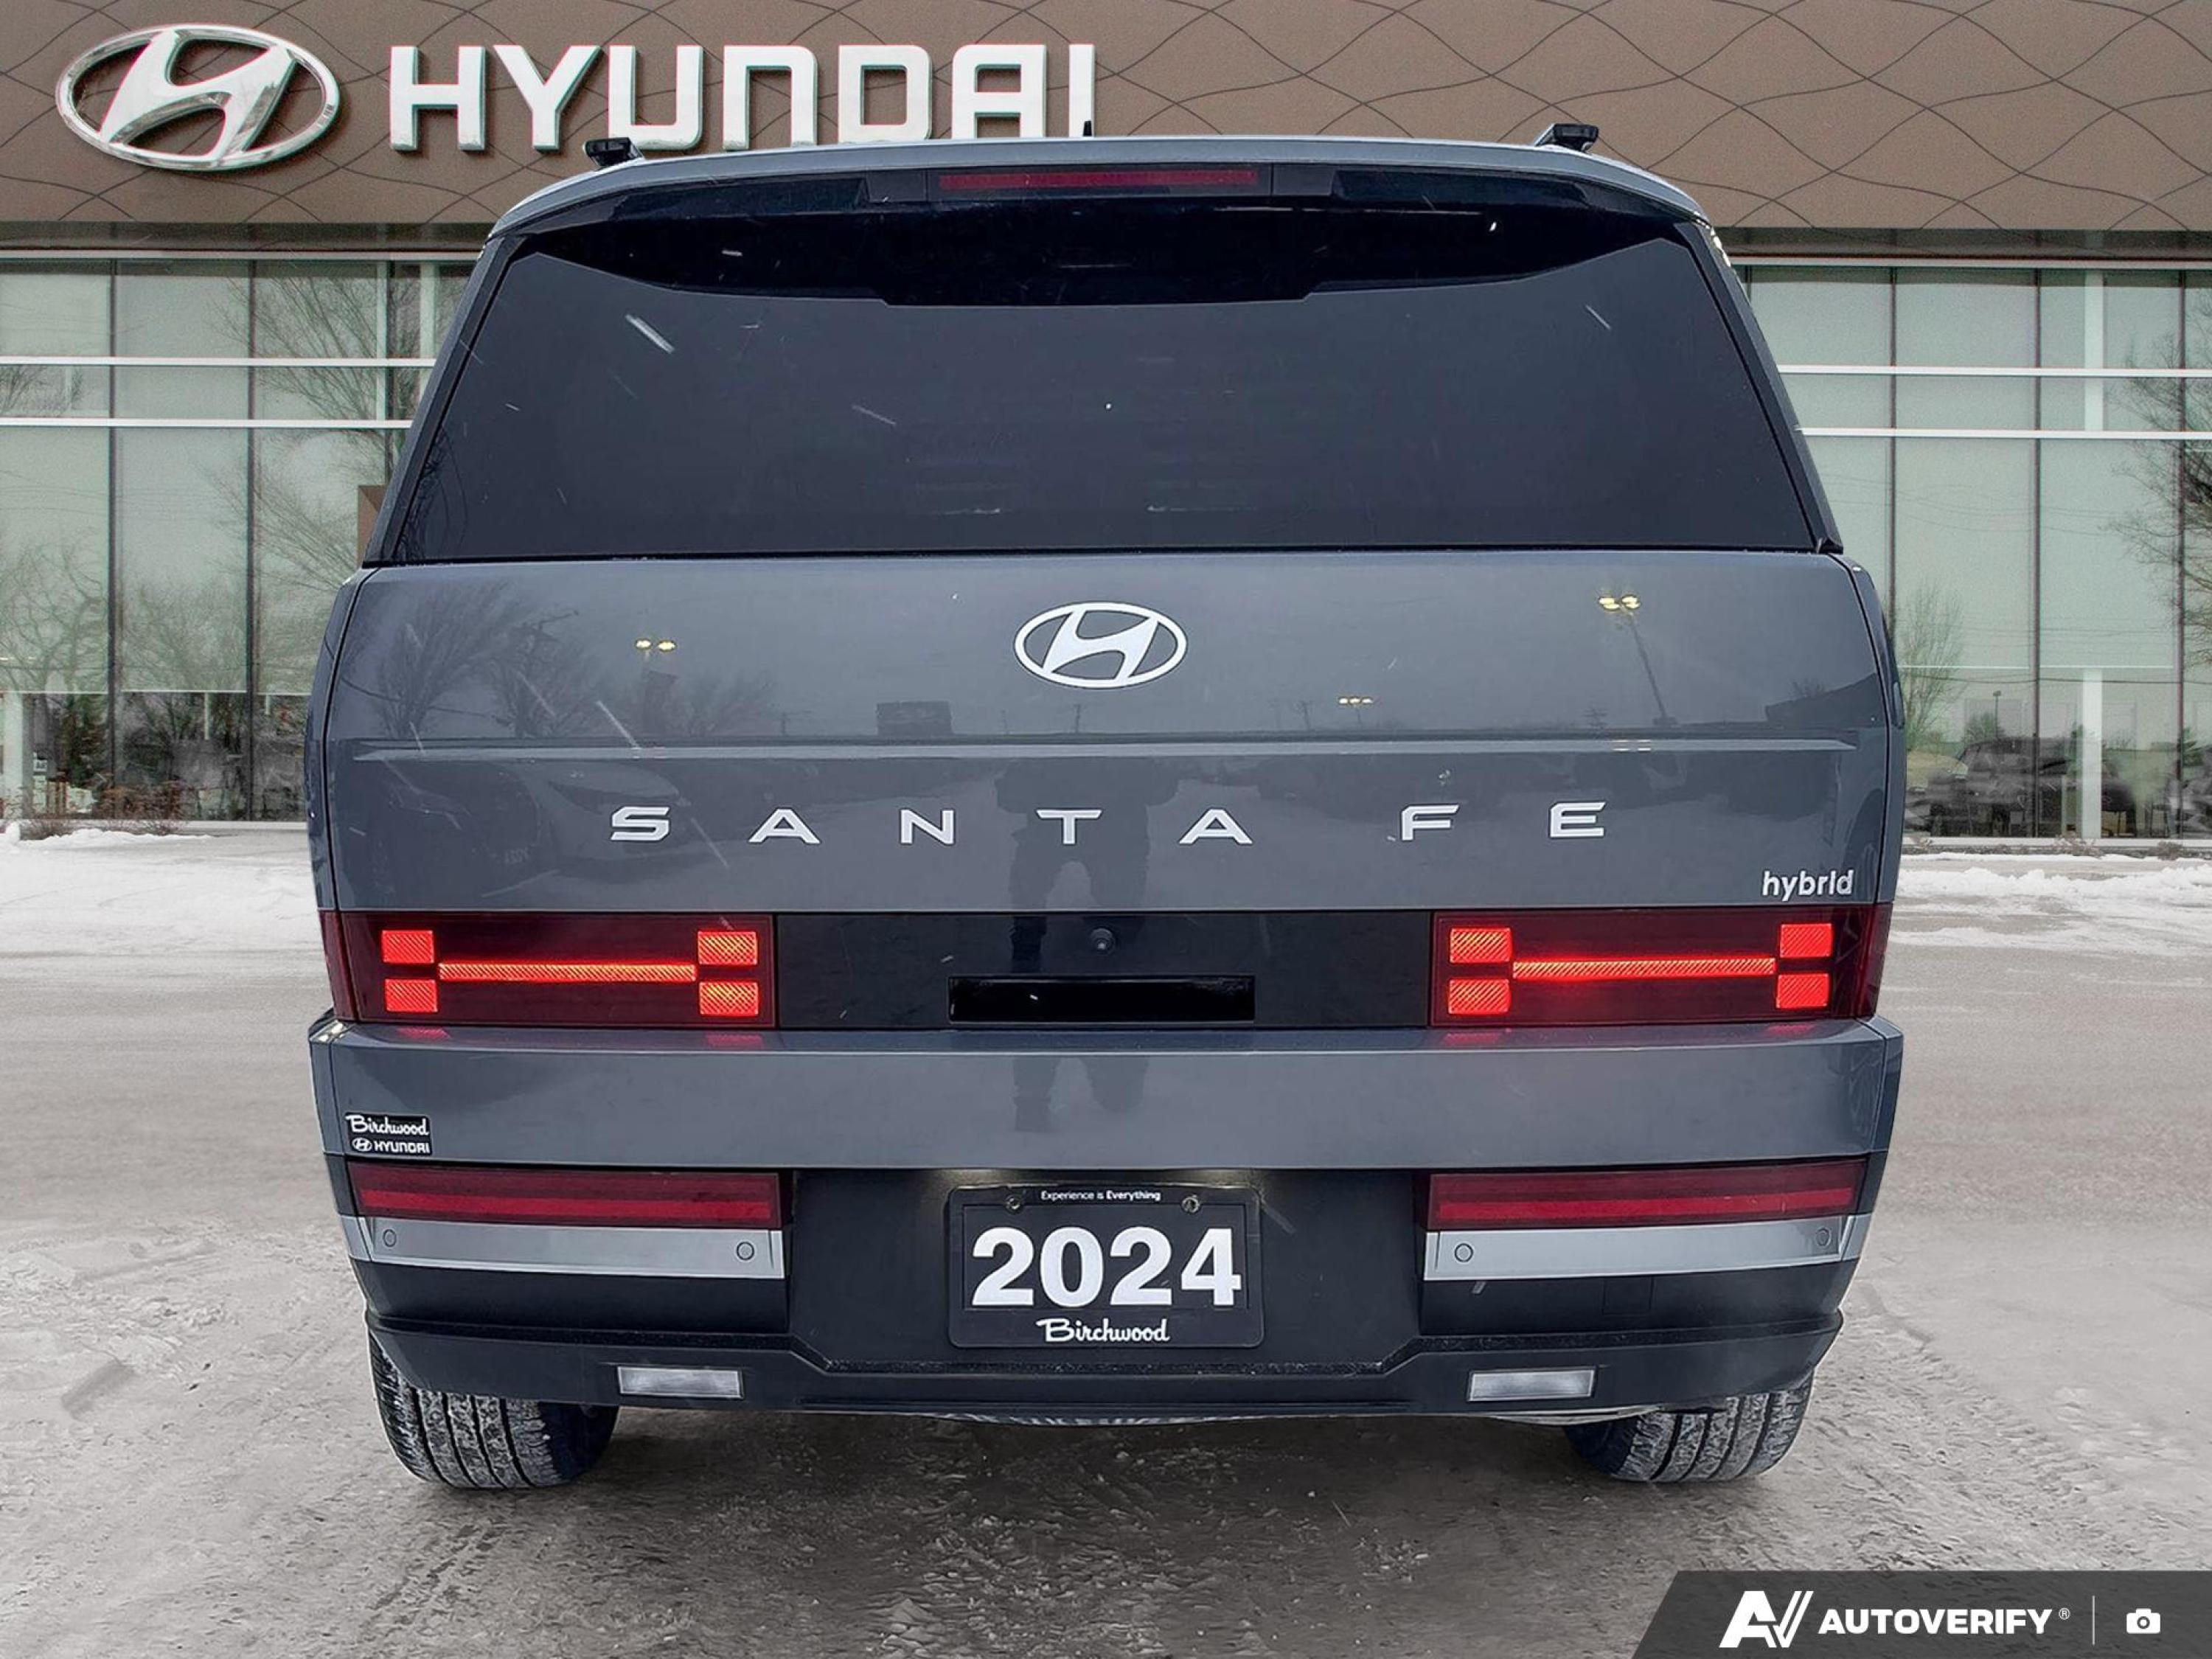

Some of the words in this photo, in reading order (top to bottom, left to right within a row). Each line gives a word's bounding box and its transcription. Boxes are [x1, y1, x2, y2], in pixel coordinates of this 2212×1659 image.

[389, 43, 1096, 152] HYUNDAI
[611, 806, 1253, 846] SANTA
[1401, 801, 1607, 841] FE
[1761, 869, 1854, 902] hybrid
[344, 1114, 430, 1135] Birchwood
[374, 1140, 431, 1154] HYUNDAI
[1040, 1190, 1095, 1201] Experience
[1106, 1189, 1161, 1201] Everything
[972, 1226, 1242, 1307] 2024
[1036, 1318, 1170, 1343] Birchwood
